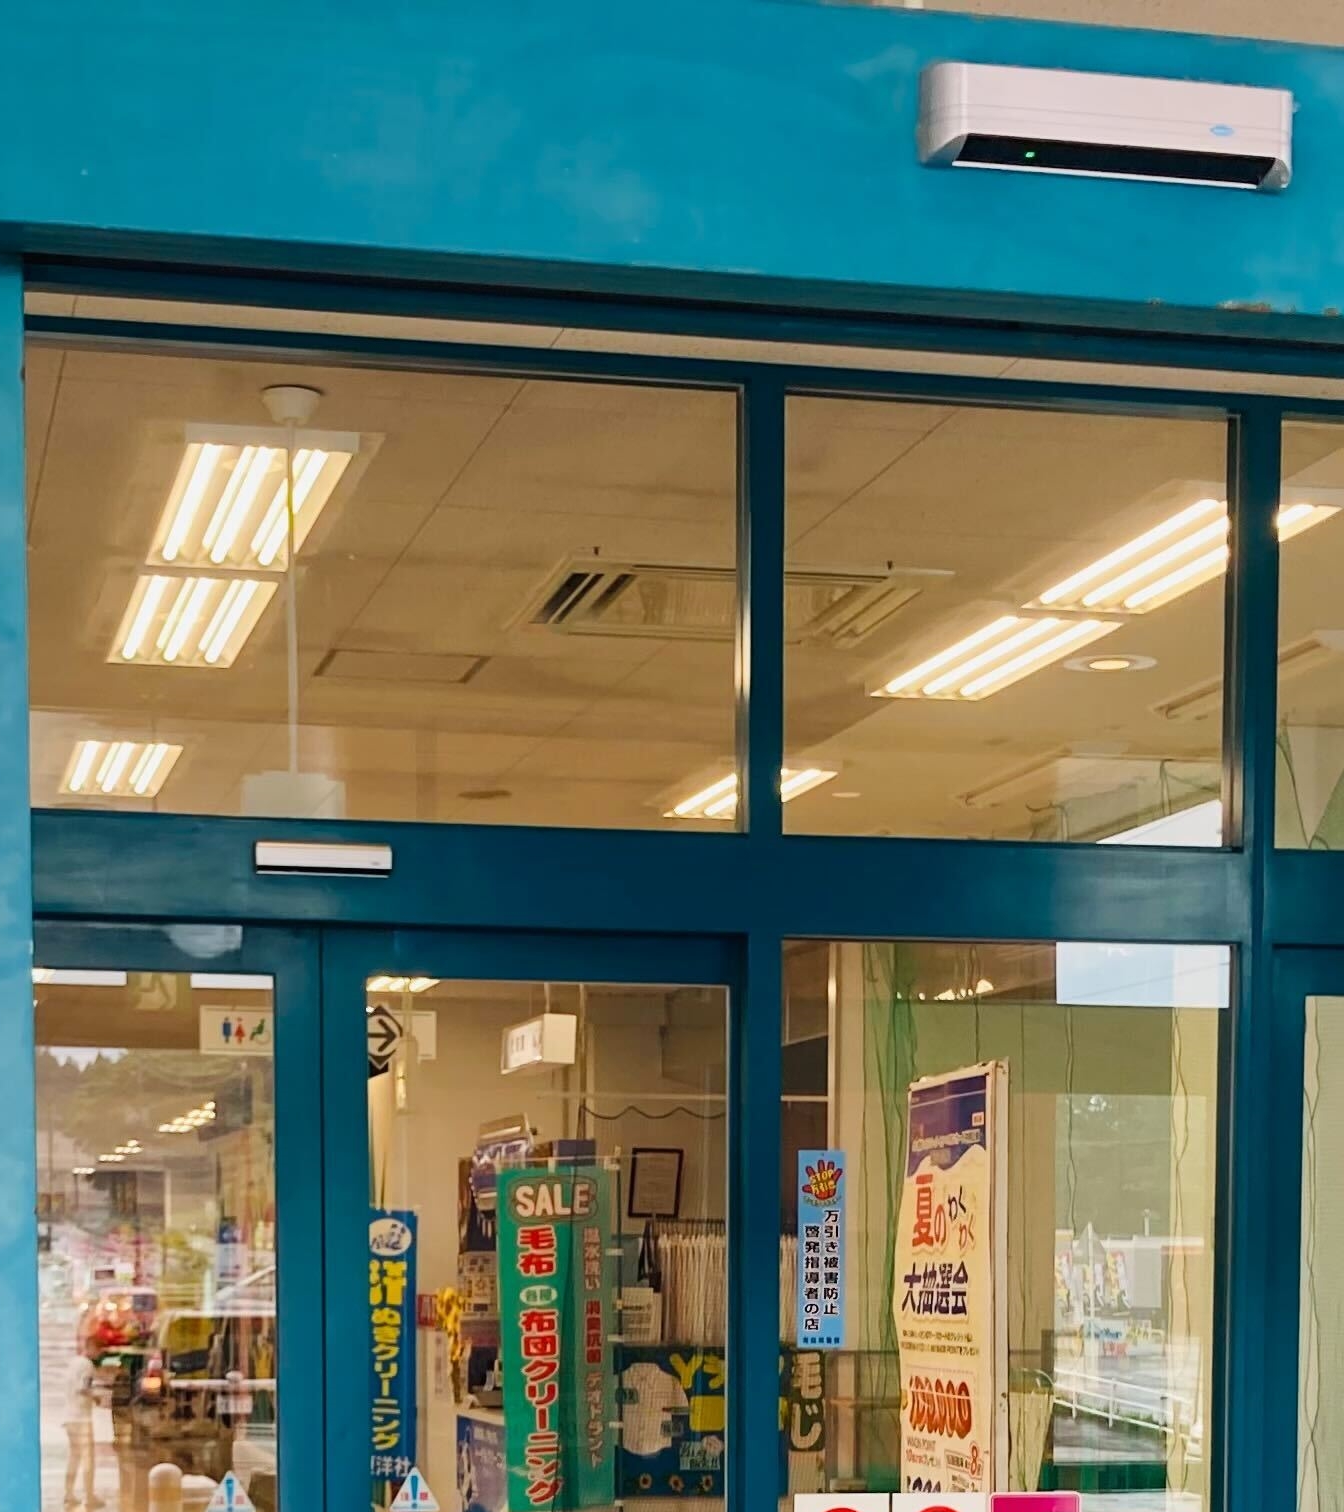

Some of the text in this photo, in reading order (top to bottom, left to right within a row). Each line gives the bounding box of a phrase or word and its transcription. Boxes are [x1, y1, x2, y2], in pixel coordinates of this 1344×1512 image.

[516, 1183, 590, 1217] SALE
[518, 1226, 556, 1276] 毛布
[804, 1225, 820, 1331] 啓発指導者の店
[823, 1209, 839, 1315] 万引き被害防止
